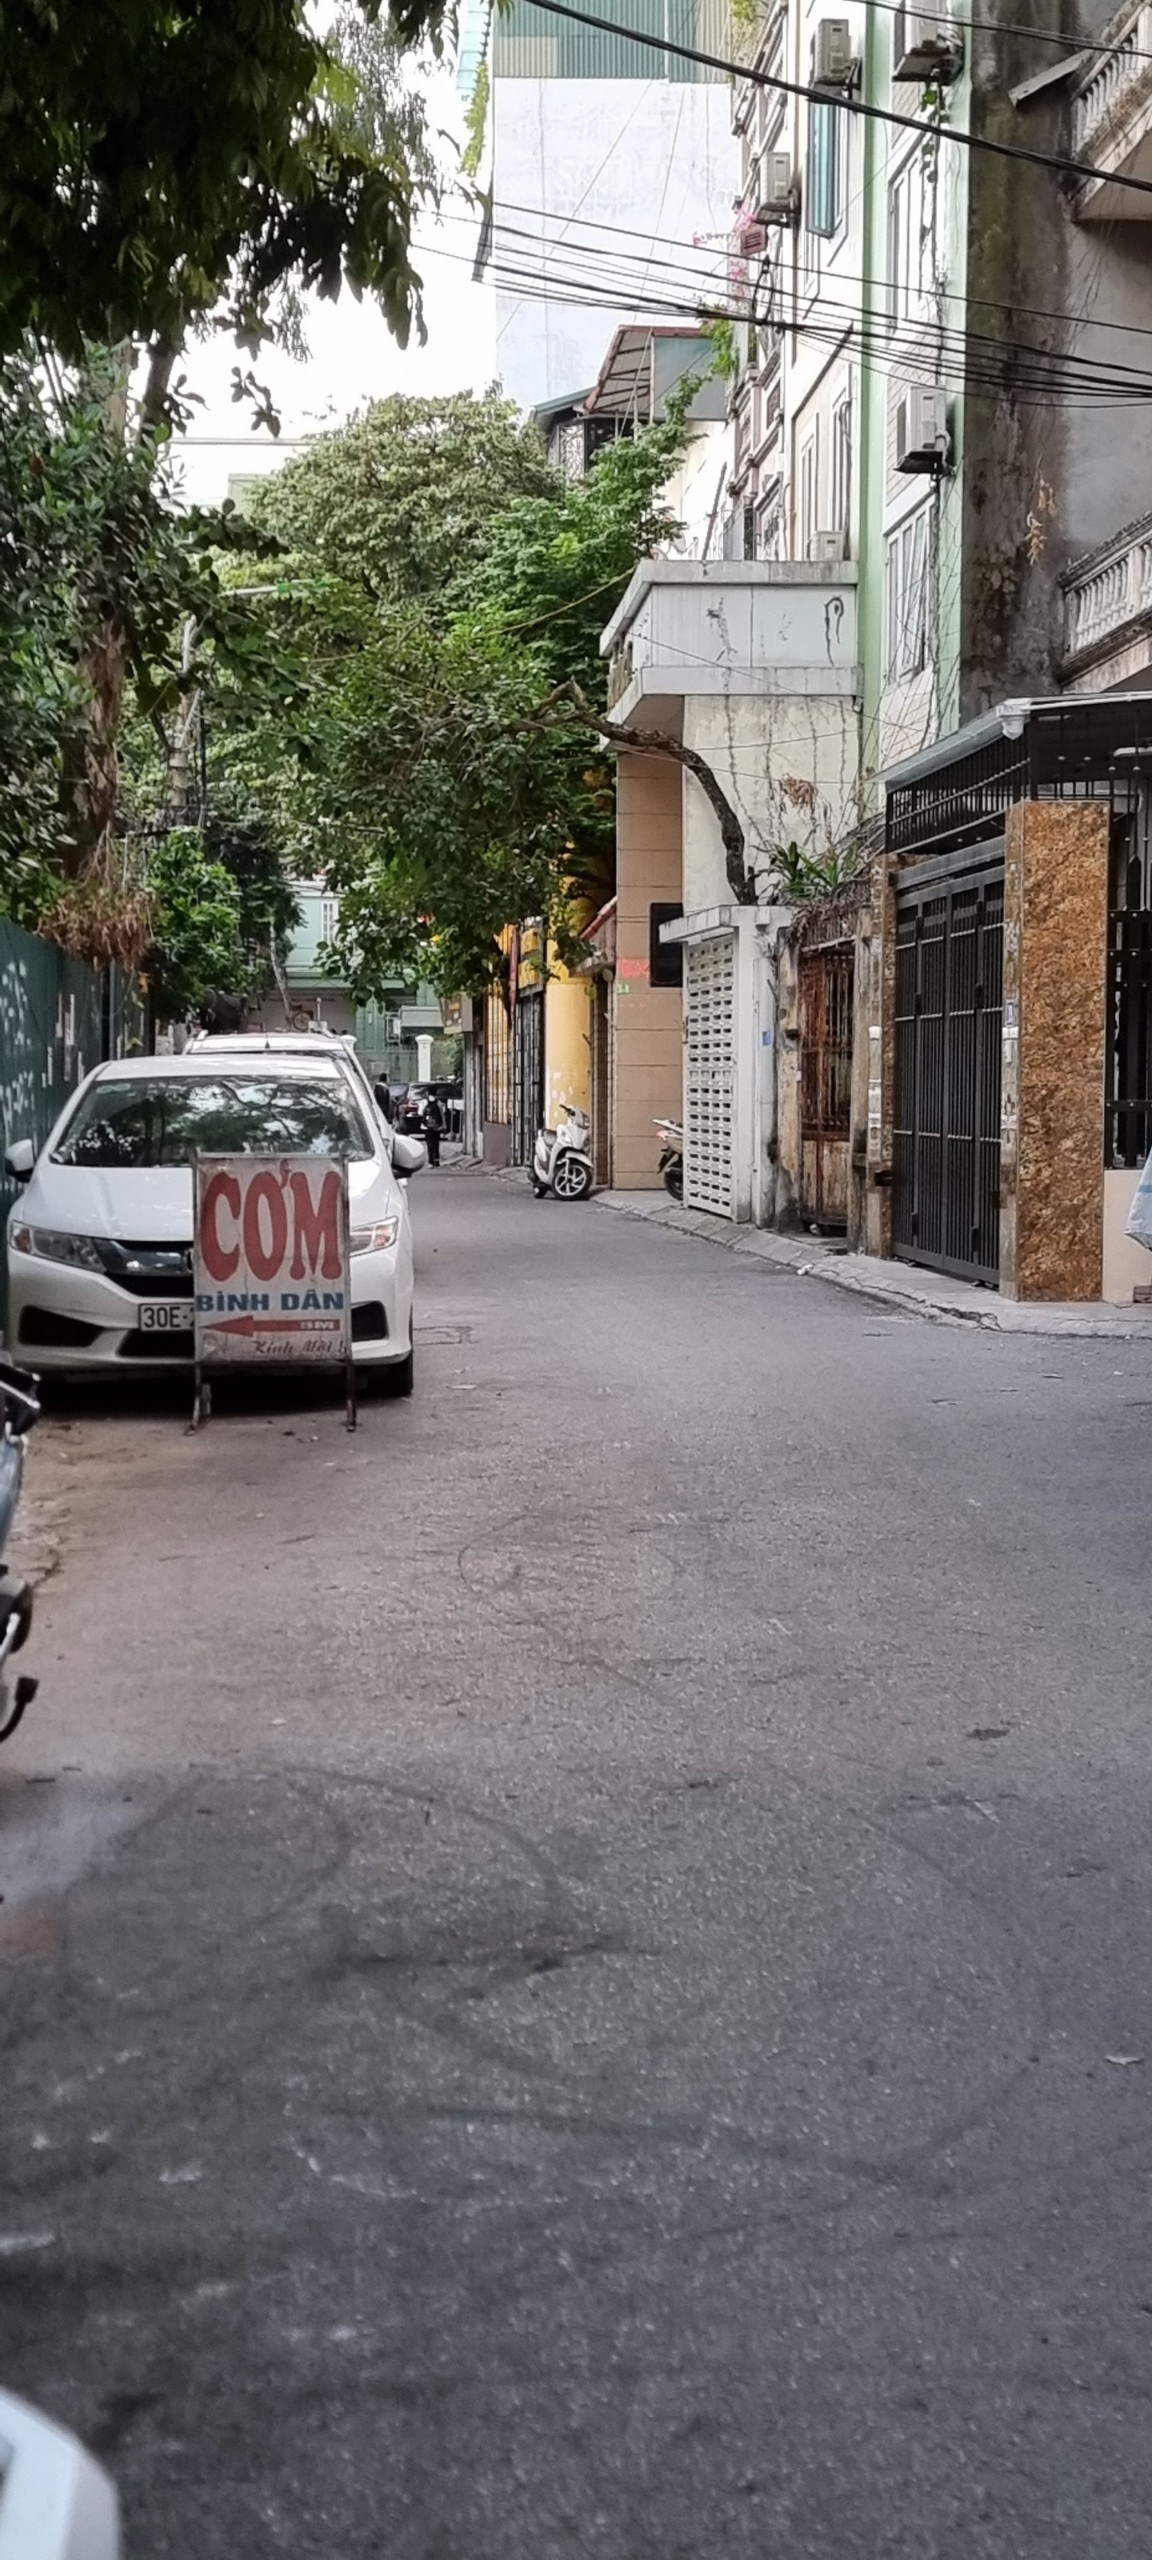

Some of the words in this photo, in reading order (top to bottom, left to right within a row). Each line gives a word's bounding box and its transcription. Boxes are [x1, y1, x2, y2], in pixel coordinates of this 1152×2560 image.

[200, 1159, 343, 1282] CƠM
[196, 1290, 270, 1312] BÌNH
[280, 1288, 344, 1311] DÂN
